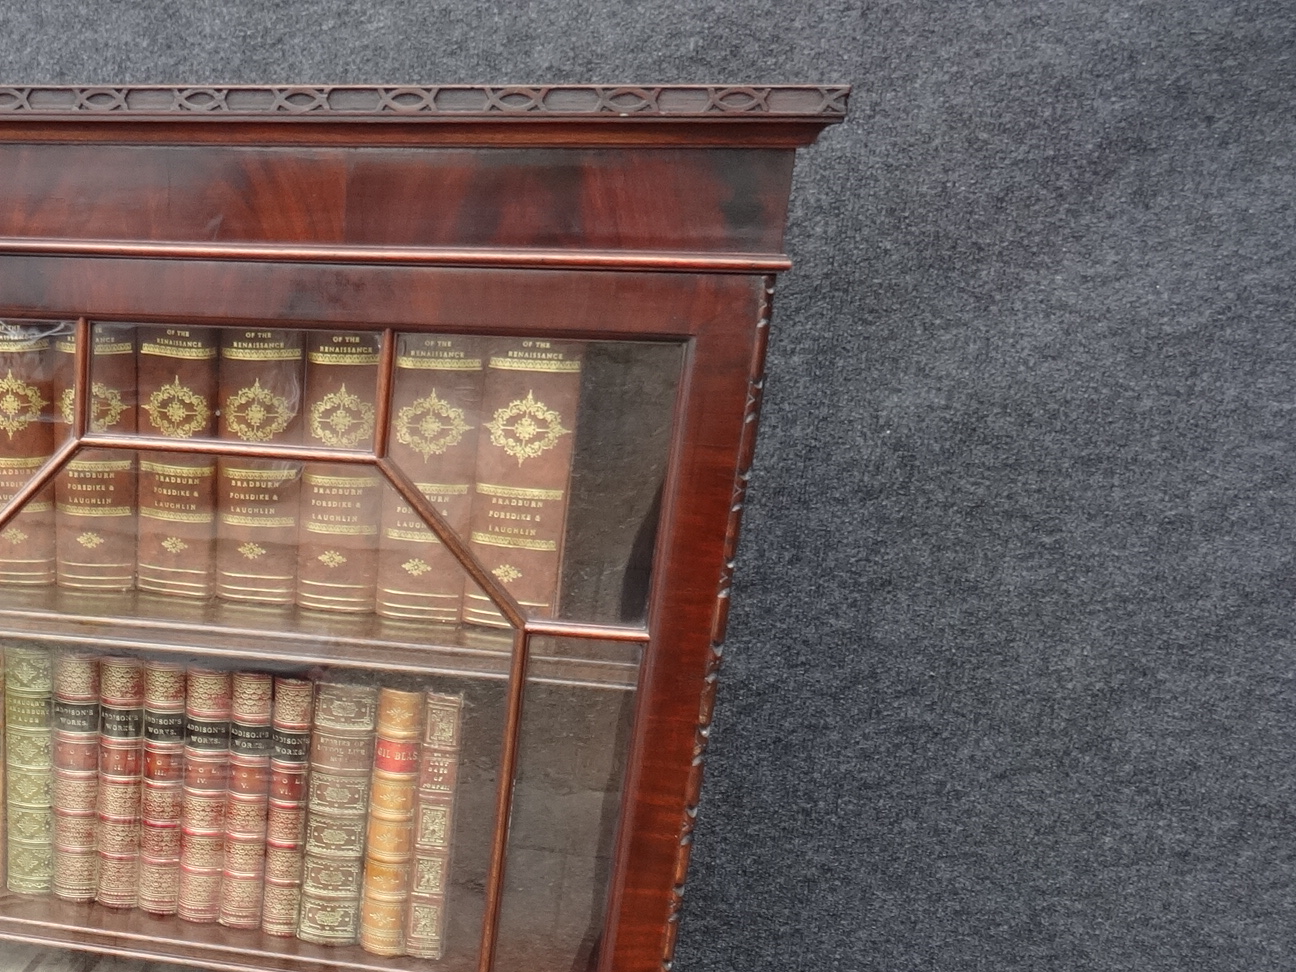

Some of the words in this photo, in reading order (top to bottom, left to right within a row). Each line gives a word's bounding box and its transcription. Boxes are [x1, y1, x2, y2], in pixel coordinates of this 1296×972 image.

[177, 330, 190, 338] THE
[245, 331, 256, 339] OF
[157, 338, 202, 347] RENAISSANCE
[332, 335, 344, 343] OF
[424, 339, 436, 347] OF
[233, 341, 284, 349] RENAISSANCE
[319, 345, 373, 354] RENAISSANCE
[535, 341, 551, 349] THE
[410, 350, 465, 359] RENAISSANCE
[508, 350, 564, 359] RENAISSANCE
[68, 471, 115, 479] BRADBURN
[156, 474, 200, 485] BRADBURN
[67, 483, 106, 492] FORSDIKE
[231, 479, 279, 489] BRADBURN
[153, 486, 190, 497] FORSDIKE
[313, 486, 363, 496] BRADBURN
[68, 496, 112, 505] LAUGHLIN
[229, 492, 270, 501] FORSDIKE
[154, 500, 197, 511] LAUGHLIN
[311, 499, 353, 508] FORSDIKE
[492, 497, 544, 508] BRADBURN
[230, 506, 276, 515] LAUGHLIN
[312, 512, 359, 523] LAUGHLIN
[488, 510, 532, 521] FORSDIKE
[488, 524, 537, 536] LAUGHLIN
[9, 705, 50, 716] ANTERBURY
[377, 747, 391, 759] GIL
[394, 751, 418, 761] BLAS
